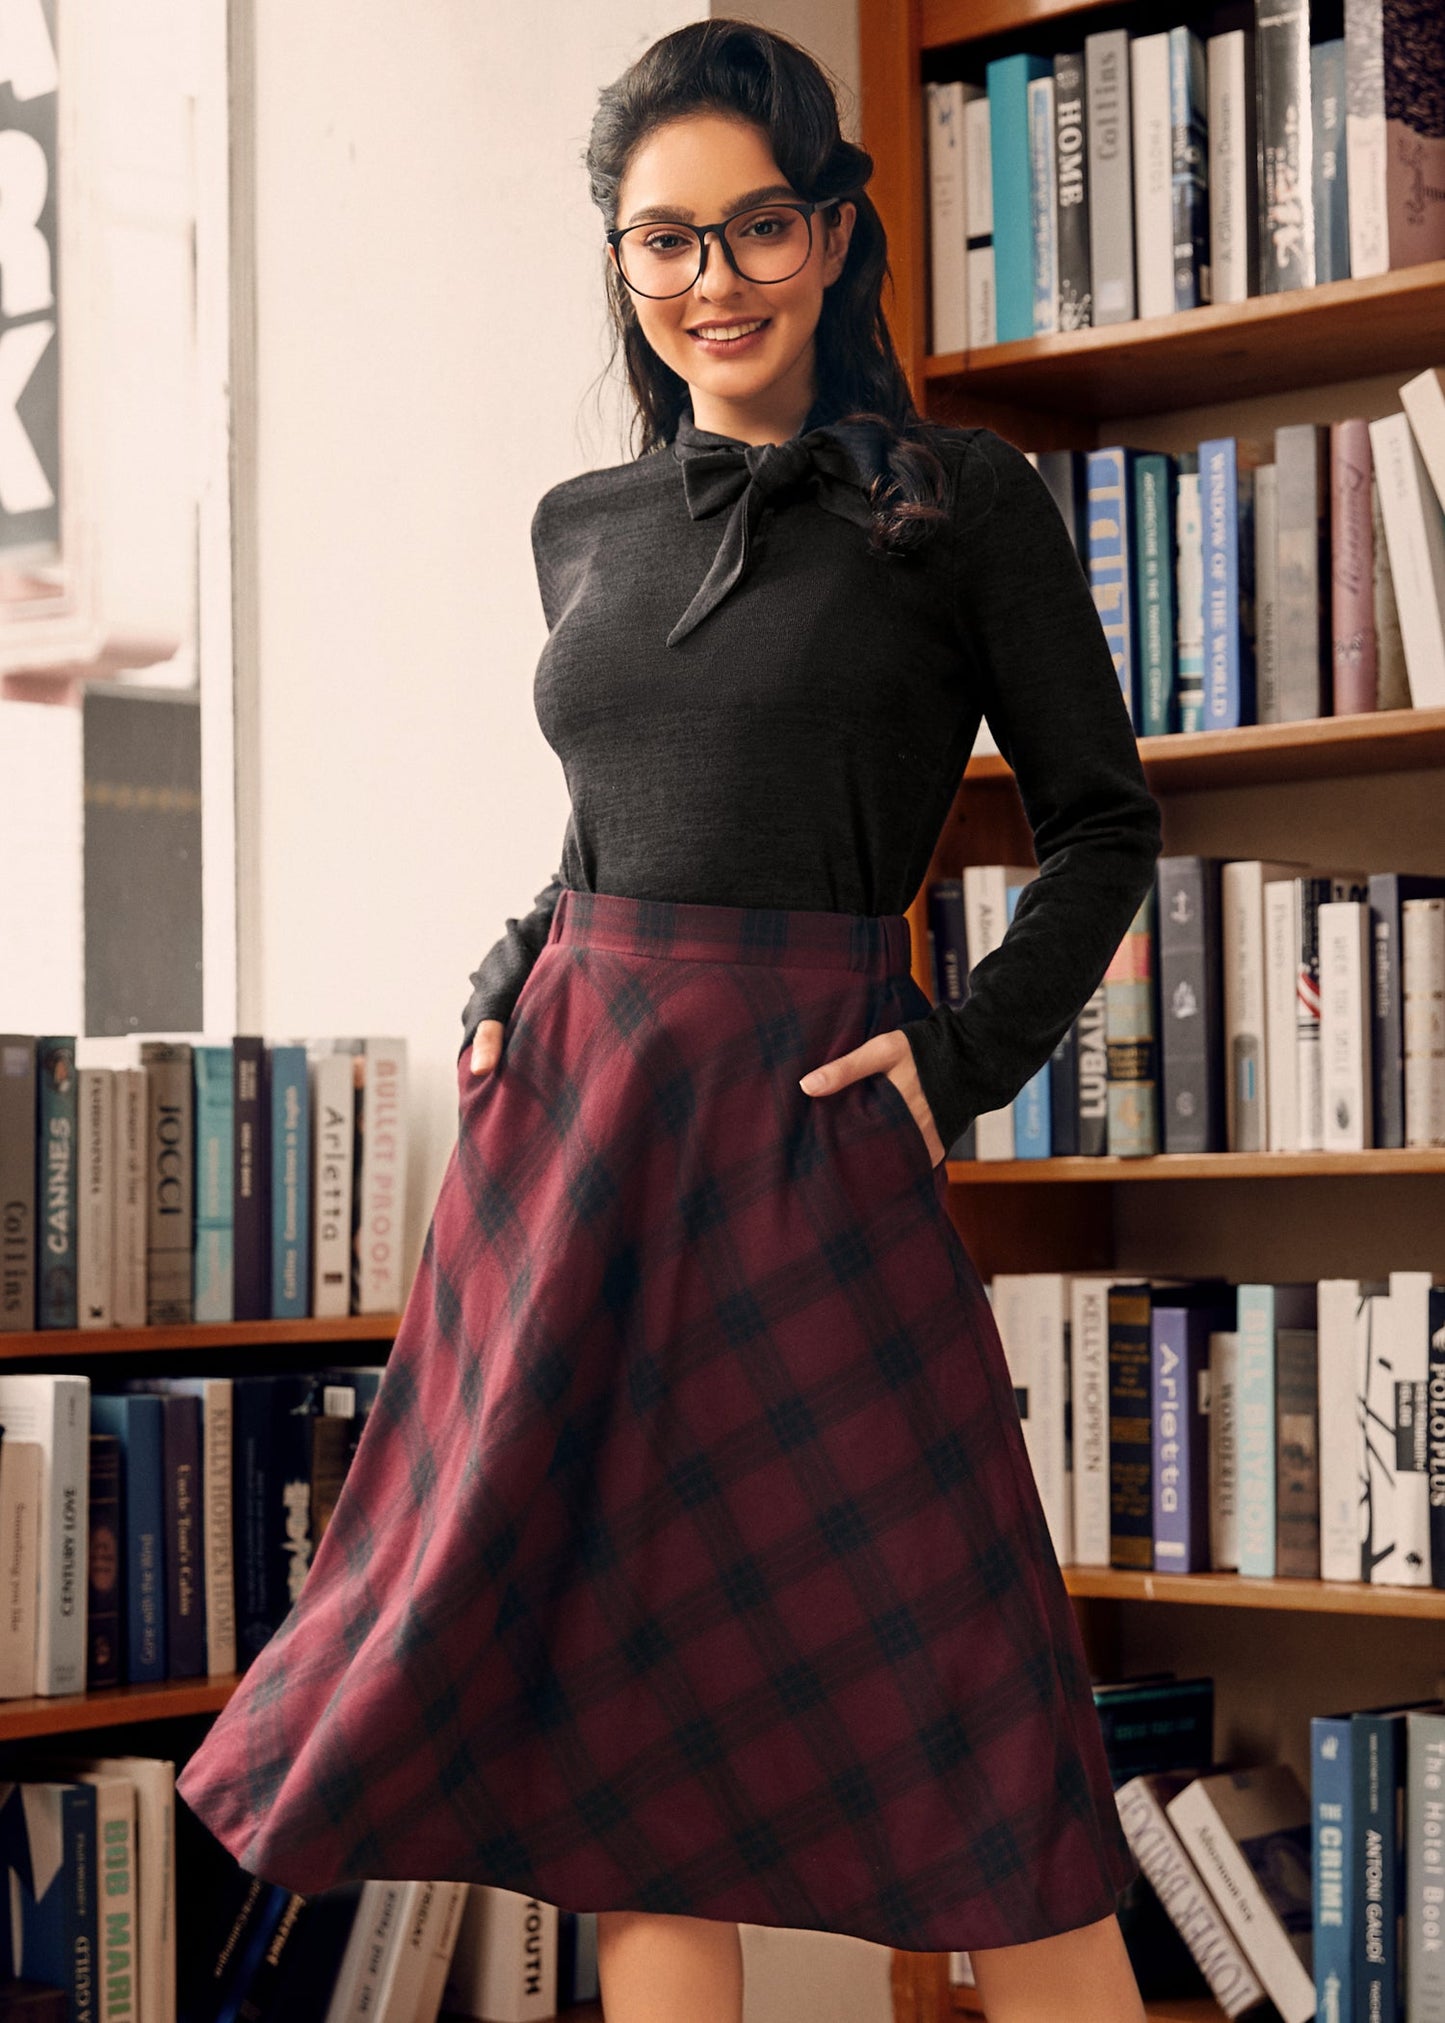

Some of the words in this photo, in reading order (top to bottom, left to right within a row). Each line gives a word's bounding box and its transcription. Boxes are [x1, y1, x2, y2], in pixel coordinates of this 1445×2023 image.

[1095, 51, 1119, 162] Collins
[1058, 99, 1083, 207] HOME
[1210, 453, 1227, 546] WINDOW
[1210, 552, 1227, 583] OF
[1210, 589, 1228, 630] THE
[1211, 635, 1228, 717] WORLD
[374, 1059, 398, 1163] BULLET
[47, 1117, 71, 1254] CANNES
[3, 1200, 28, 1312] Collins
[1082, 1294, 1102, 1365] KELLY
[1243, 1308, 1268, 1389] BILL
[210, 1408, 230, 1478] KELLY
[1083, 1371, 1103, 1472] HOPPEN
[62, 1486, 77, 1530] LOVE
[177, 1464, 192, 1510] Uncle
[1242, 1402, 1268, 1556] BRYSON
[211, 1484, 231, 1577] HOPPEN
[60, 1535, 76, 1617] CENTURY
[178, 1566, 194, 1616] Cabin
[213, 1582, 232, 1650] HOME
[1424, 1739, 1444, 1790] The
[1118, 1787, 1191, 1901] BRIDGE
[1319, 1803, 1342, 1822] THE
[1423, 1801, 1444, 1874] Hotel
[105, 1821, 130, 1897] BOB
[1320, 1825, 1343, 1928] CRIME
[1365, 1829, 1383, 1902] ANTONI
[525, 1900, 543, 1996] YOUTH
[1177, 1900, 1252, 2013] TOWER
[1422, 1885, 1444, 1953] Book
[106, 1912, 132, 2023] MARL
